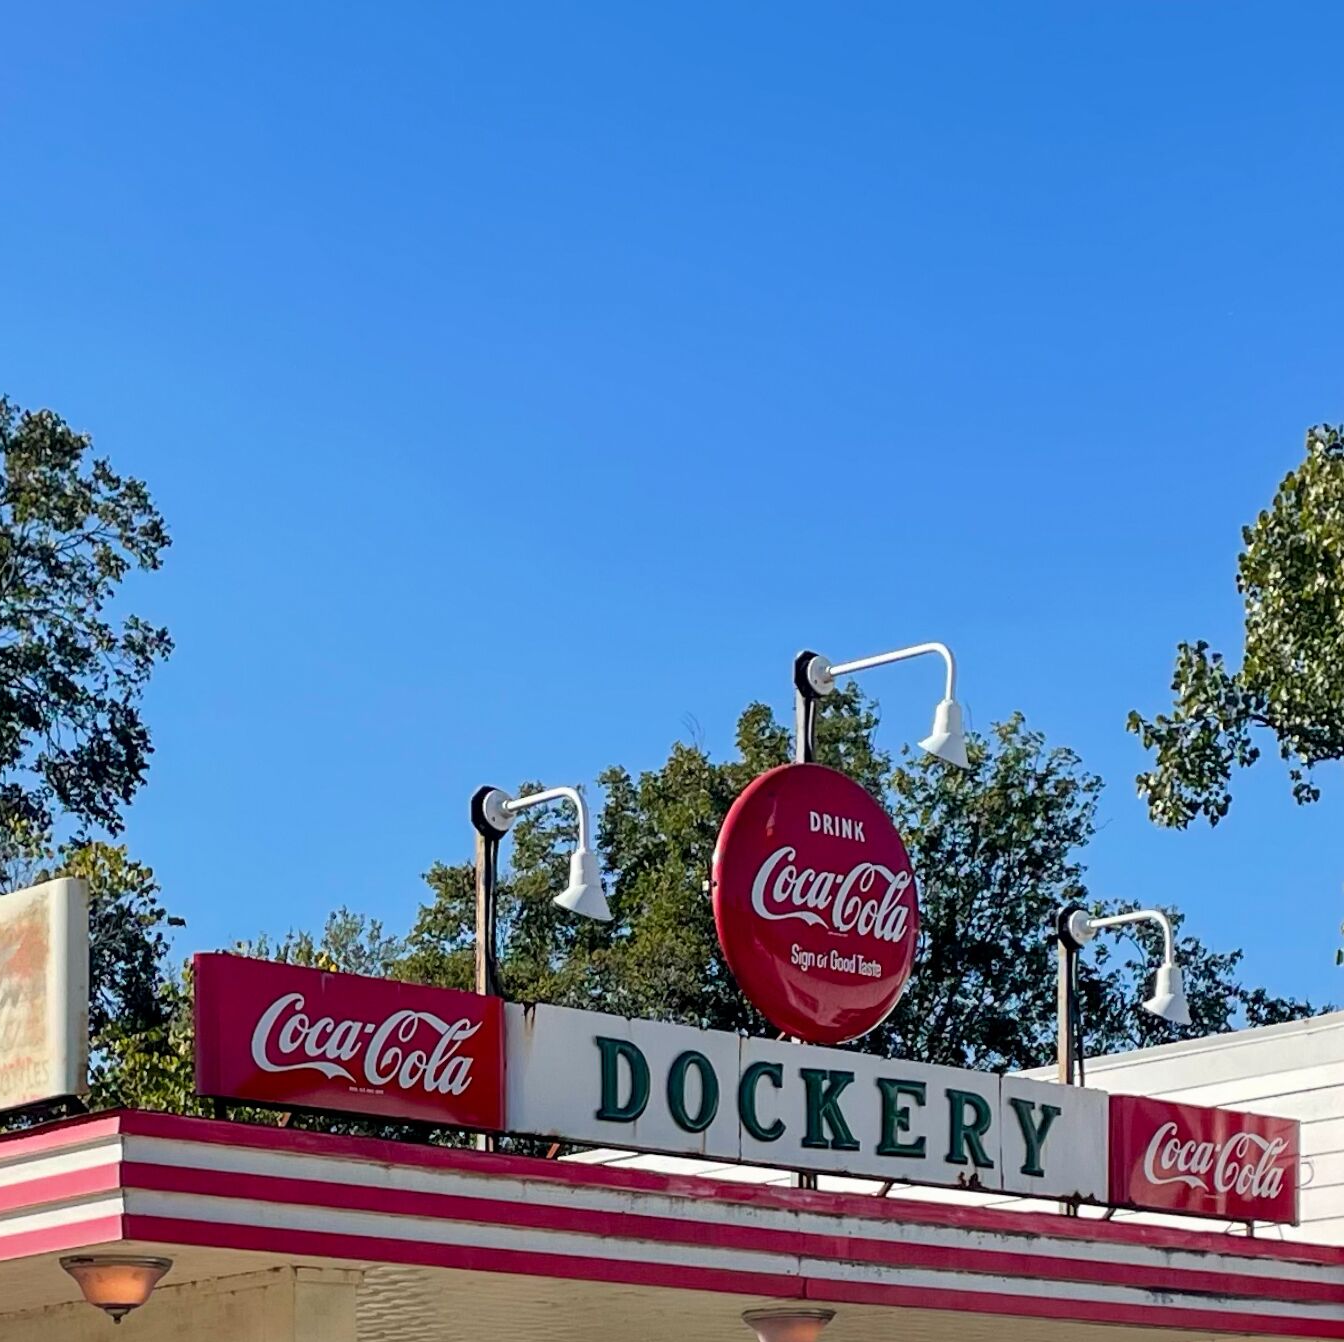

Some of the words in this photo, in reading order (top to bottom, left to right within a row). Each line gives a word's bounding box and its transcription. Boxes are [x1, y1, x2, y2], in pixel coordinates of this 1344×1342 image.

[809, 811, 865, 842] DRINK
[751, 846, 912, 943] Coca-Cola
[791, 943, 815, 972] Sign
[830, 950, 856, 974] Good
[857, 955, 882, 979] Taste
[251, 992, 484, 1096] Coca-Cola
[595, 1036, 1062, 1177] DOCKERY
[1143, 1121, 1290, 1199] Coca-Cola
